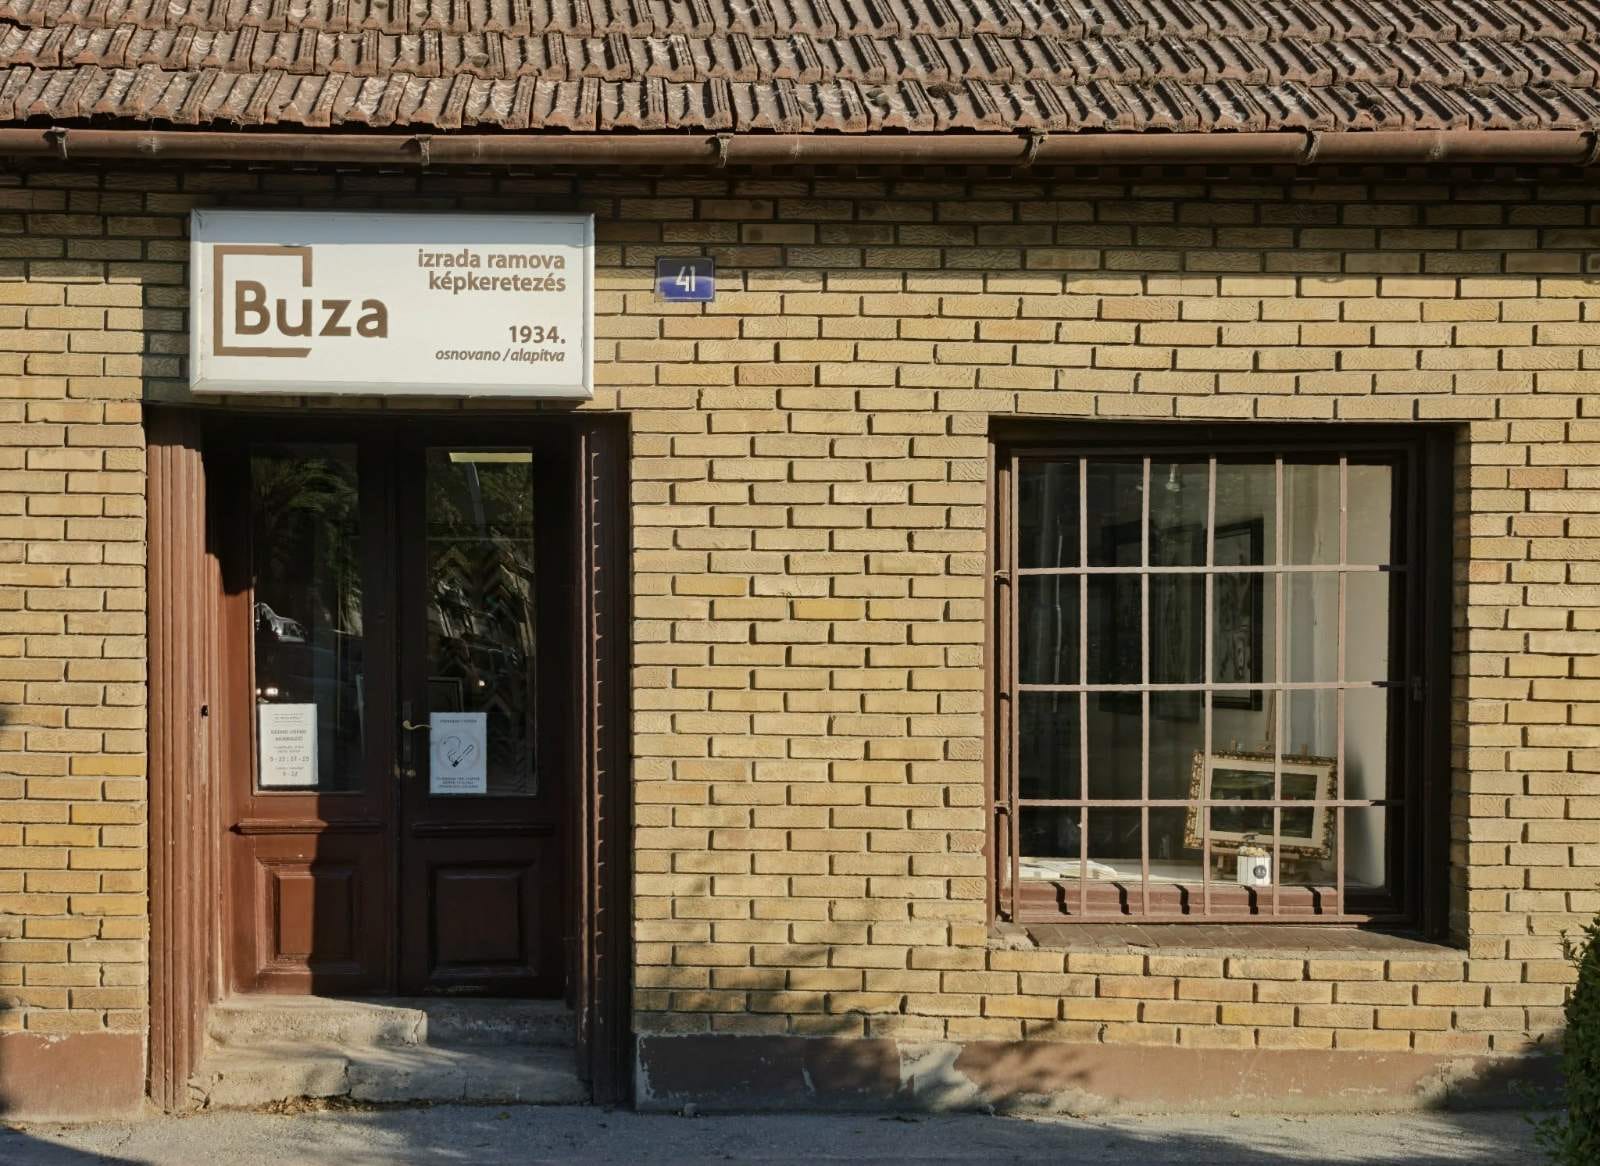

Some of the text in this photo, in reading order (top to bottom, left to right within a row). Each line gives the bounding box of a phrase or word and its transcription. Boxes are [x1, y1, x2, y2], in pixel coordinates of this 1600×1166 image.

[417, 248, 566, 270] izrada ramova
[428, 270, 567, 295] képkeretezés
[675, 265, 696, 292] 41
[235, 279, 389, 338] Buza
[508, 324, 566, 345] 1934.
